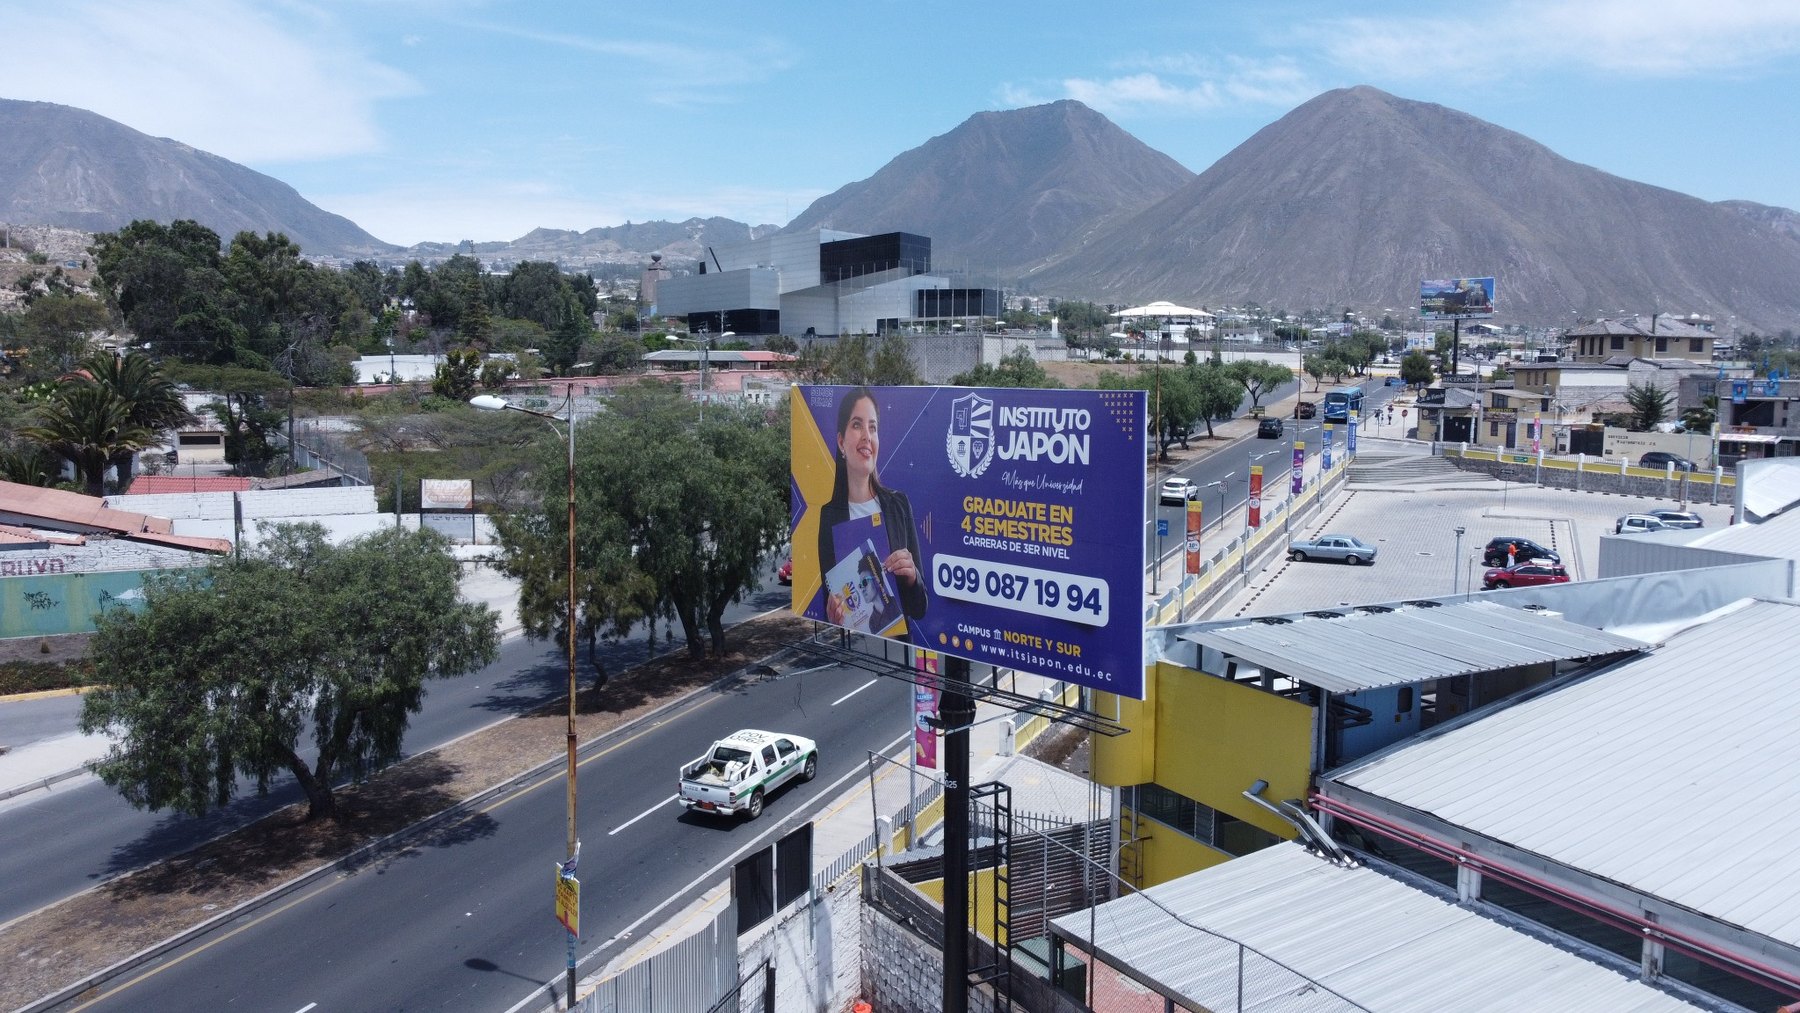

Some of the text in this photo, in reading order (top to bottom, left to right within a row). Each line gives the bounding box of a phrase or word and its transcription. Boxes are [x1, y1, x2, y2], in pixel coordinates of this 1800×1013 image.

[999, 407, 1091, 431] INSTITUTO
[998, 427, 1090, 465] JAPÓN
[1001, 469, 1084, 495] Más que Universidad
[963, 496, 1073, 524] GRADUATE EN
[961, 515, 1073, 546] 4 SEMESTRES
[963, 535, 1070, 560] CARRERAS DE 3ER NIVEL
[938, 563, 1102, 615] 099 087 19 94
[957, 623, 1082, 657] CAMPUS NORTE Y SUR
[981, 644, 1112, 681] www.itsjapon.edu.ec
